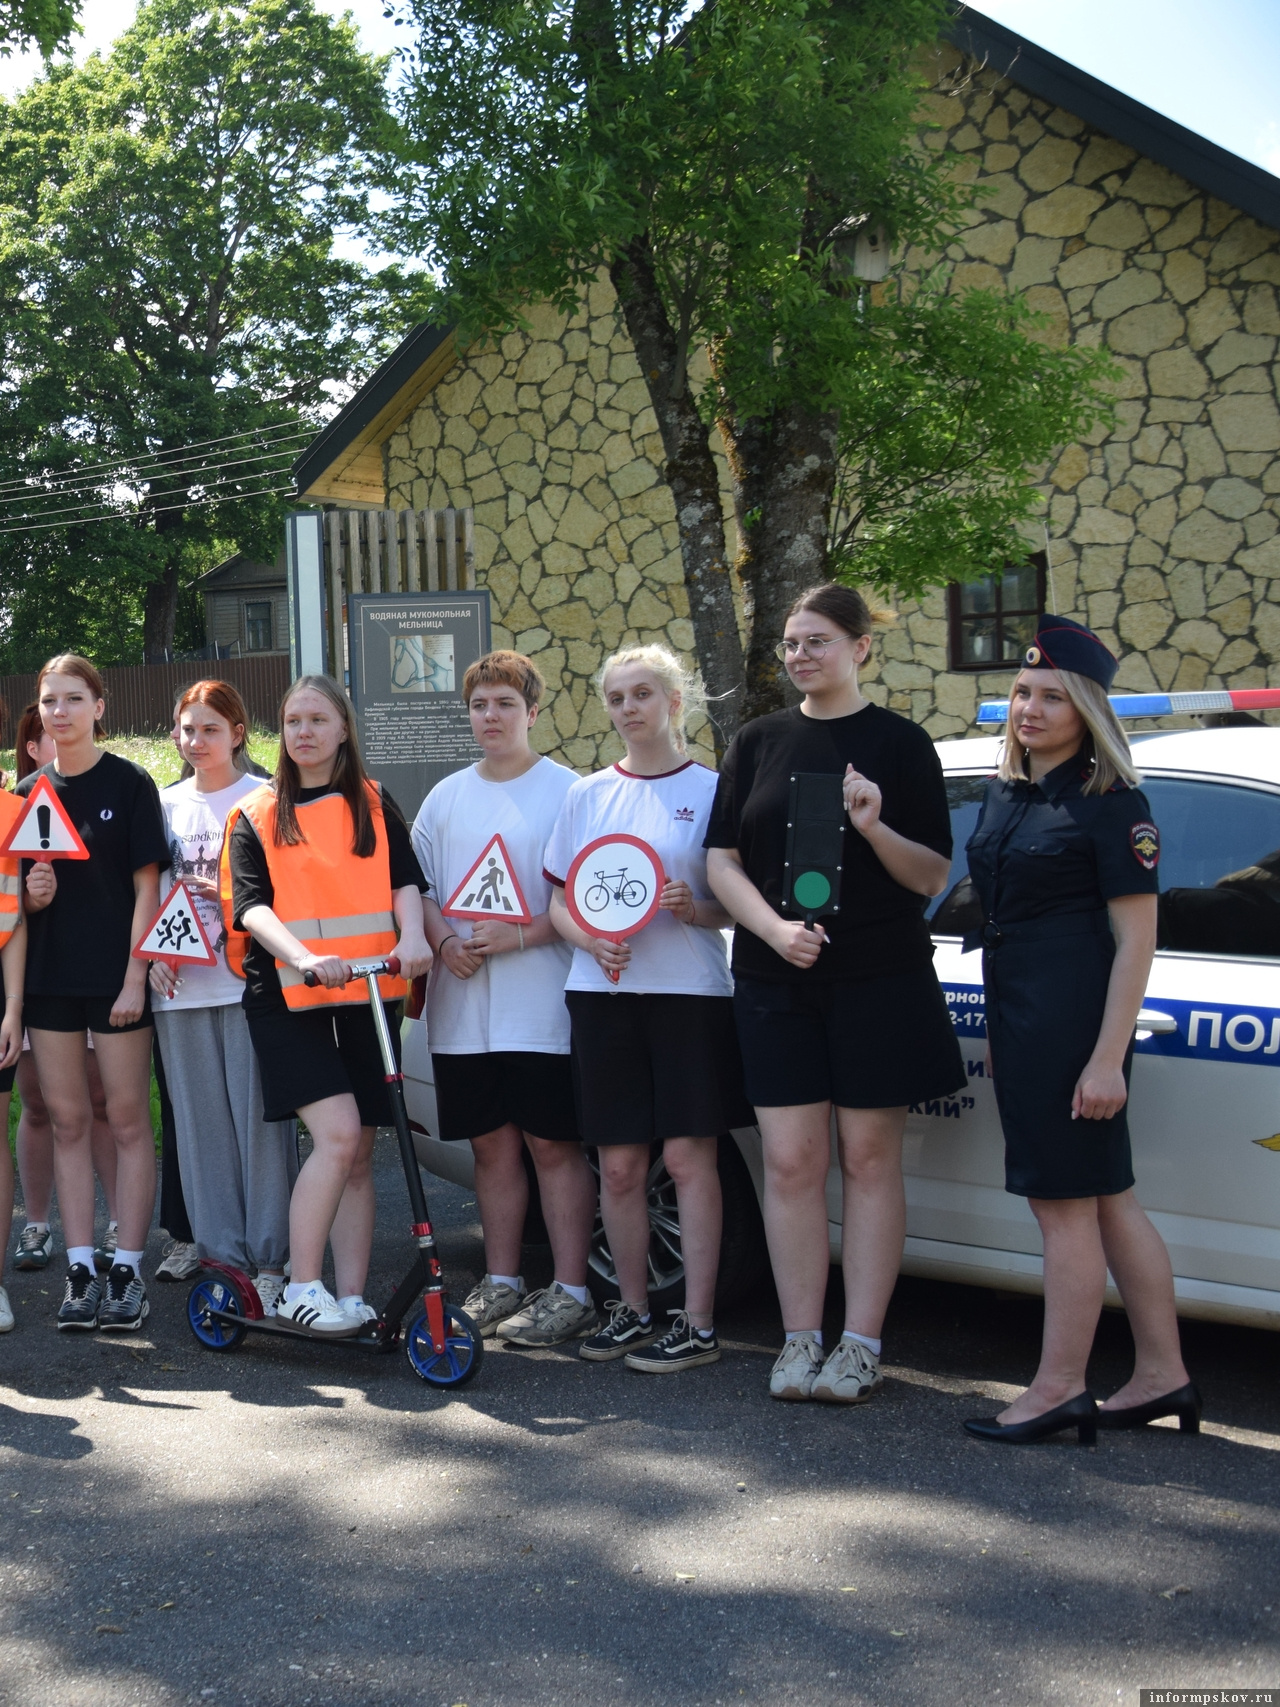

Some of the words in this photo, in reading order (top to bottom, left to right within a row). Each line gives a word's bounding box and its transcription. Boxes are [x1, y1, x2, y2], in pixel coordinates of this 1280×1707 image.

[370, 612, 407, 620] ВОДЯНАЯ
[410, 610, 471, 619] МУКОМОЛЬНАЯ
[398, 620, 443, 629] МЕЛЬНИЦА
